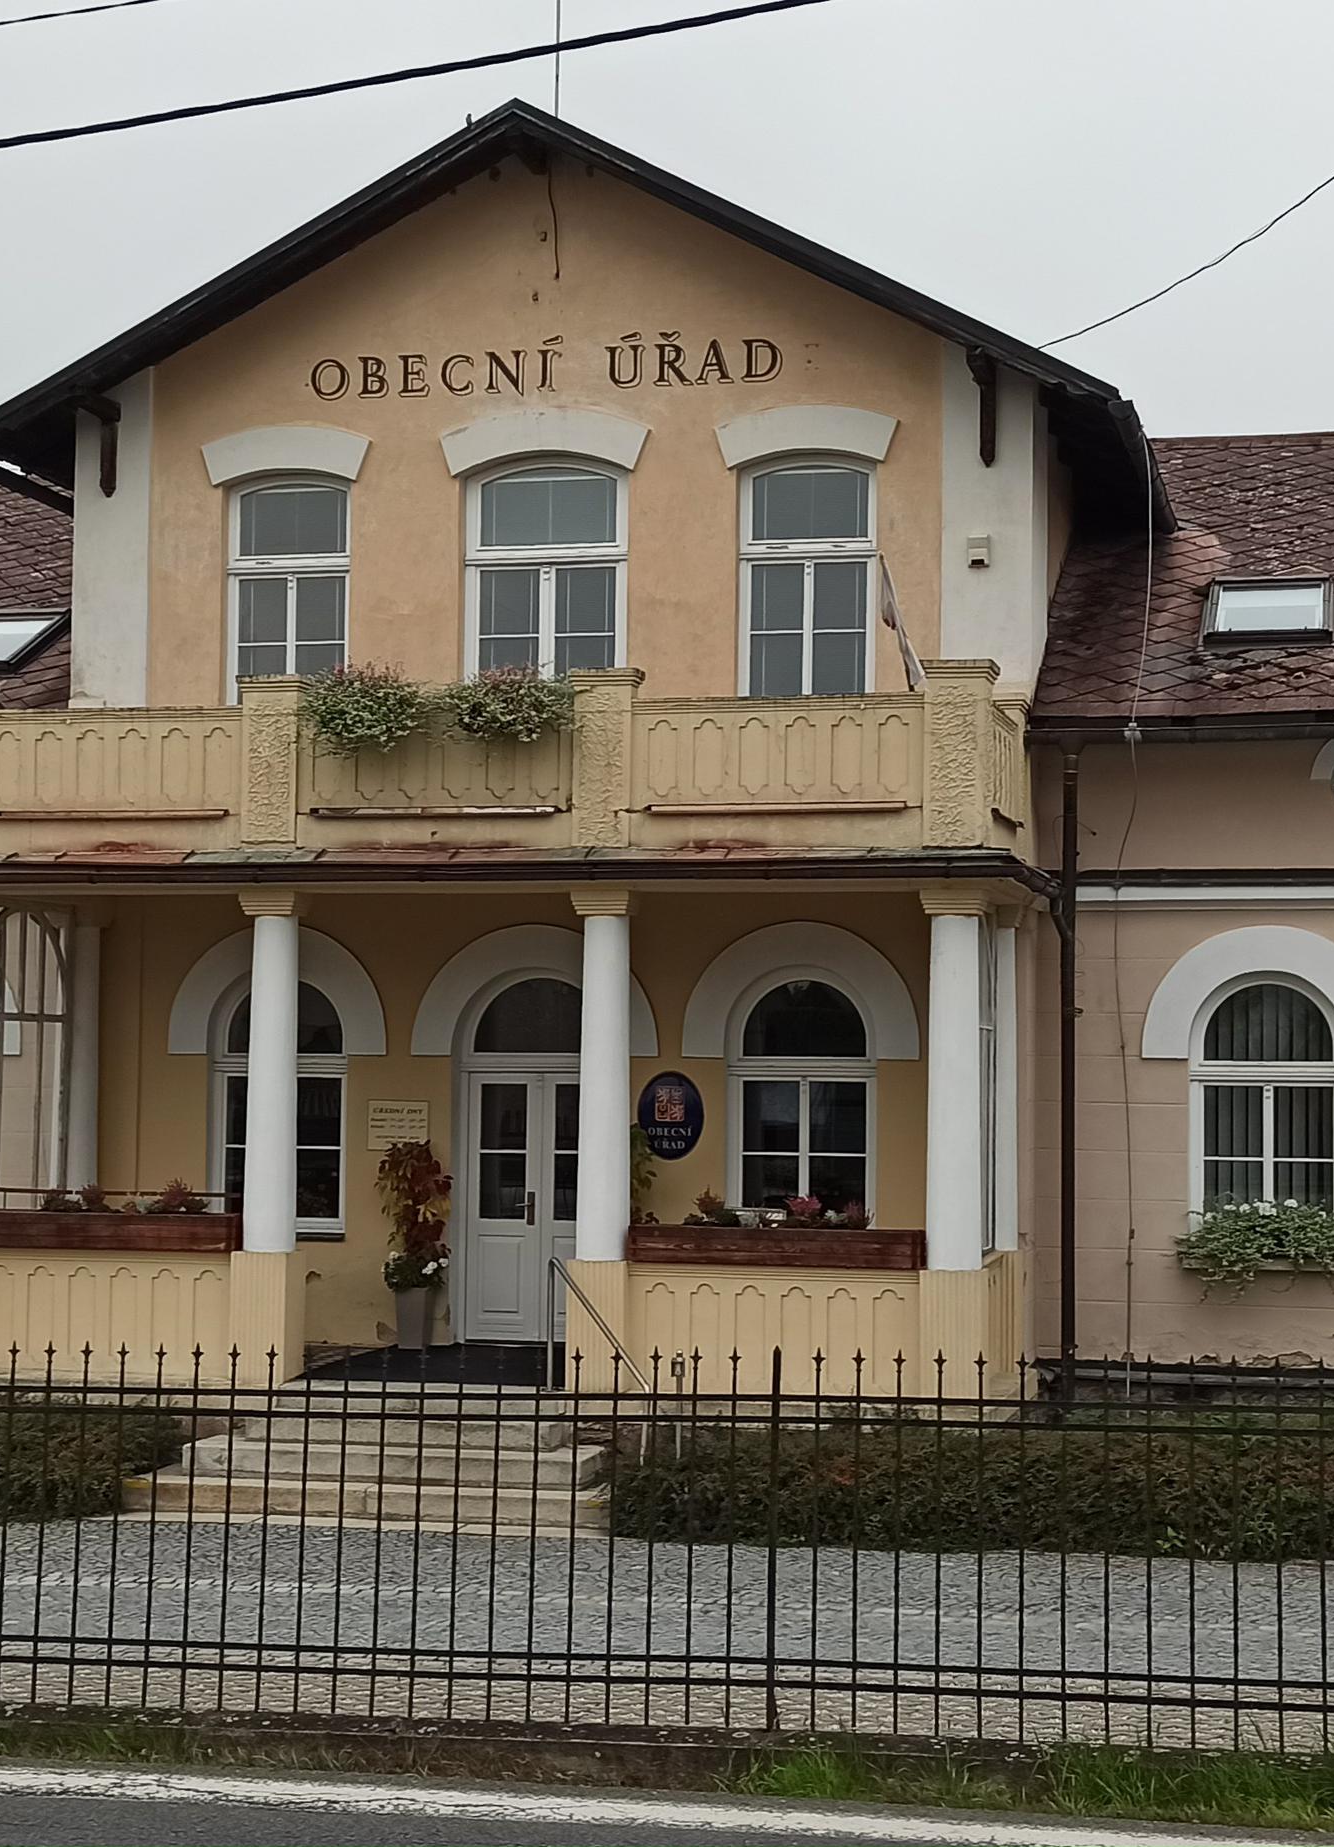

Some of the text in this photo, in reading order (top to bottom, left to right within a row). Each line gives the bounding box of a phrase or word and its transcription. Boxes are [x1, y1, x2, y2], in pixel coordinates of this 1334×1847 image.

[309, 330, 784, 401] OBECNÍ ÚŘAD
[647, 1125, 692, 1137] OBECNÍ
